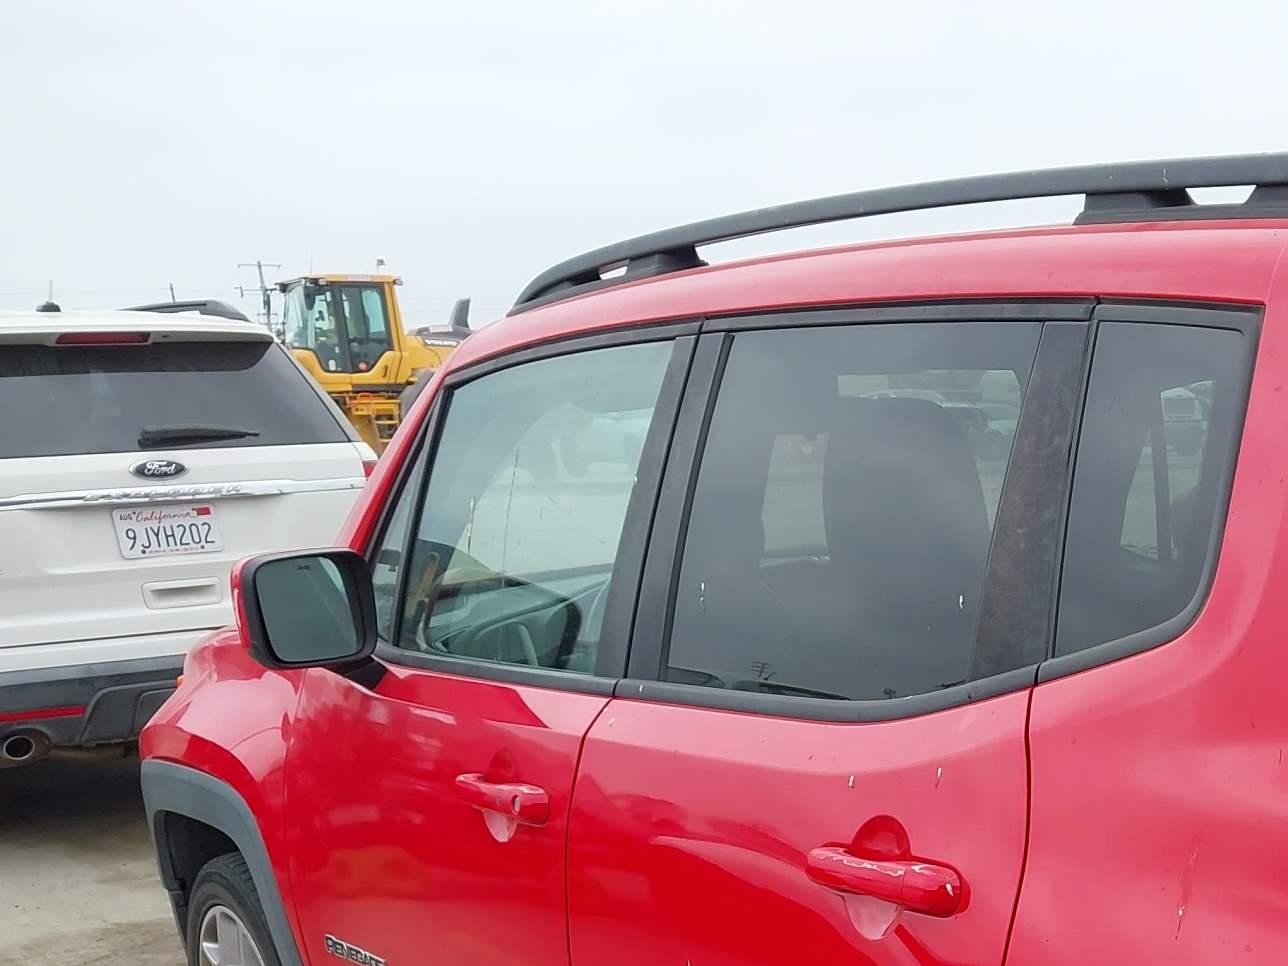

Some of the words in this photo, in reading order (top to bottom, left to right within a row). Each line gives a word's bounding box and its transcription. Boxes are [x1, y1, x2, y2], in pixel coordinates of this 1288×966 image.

[144, 460, 177, 475] Ford
[119, 511, 133, 521] AUG
[135, 510, 194, 524] California
[125, 521, 216, 551] 9JYH202
